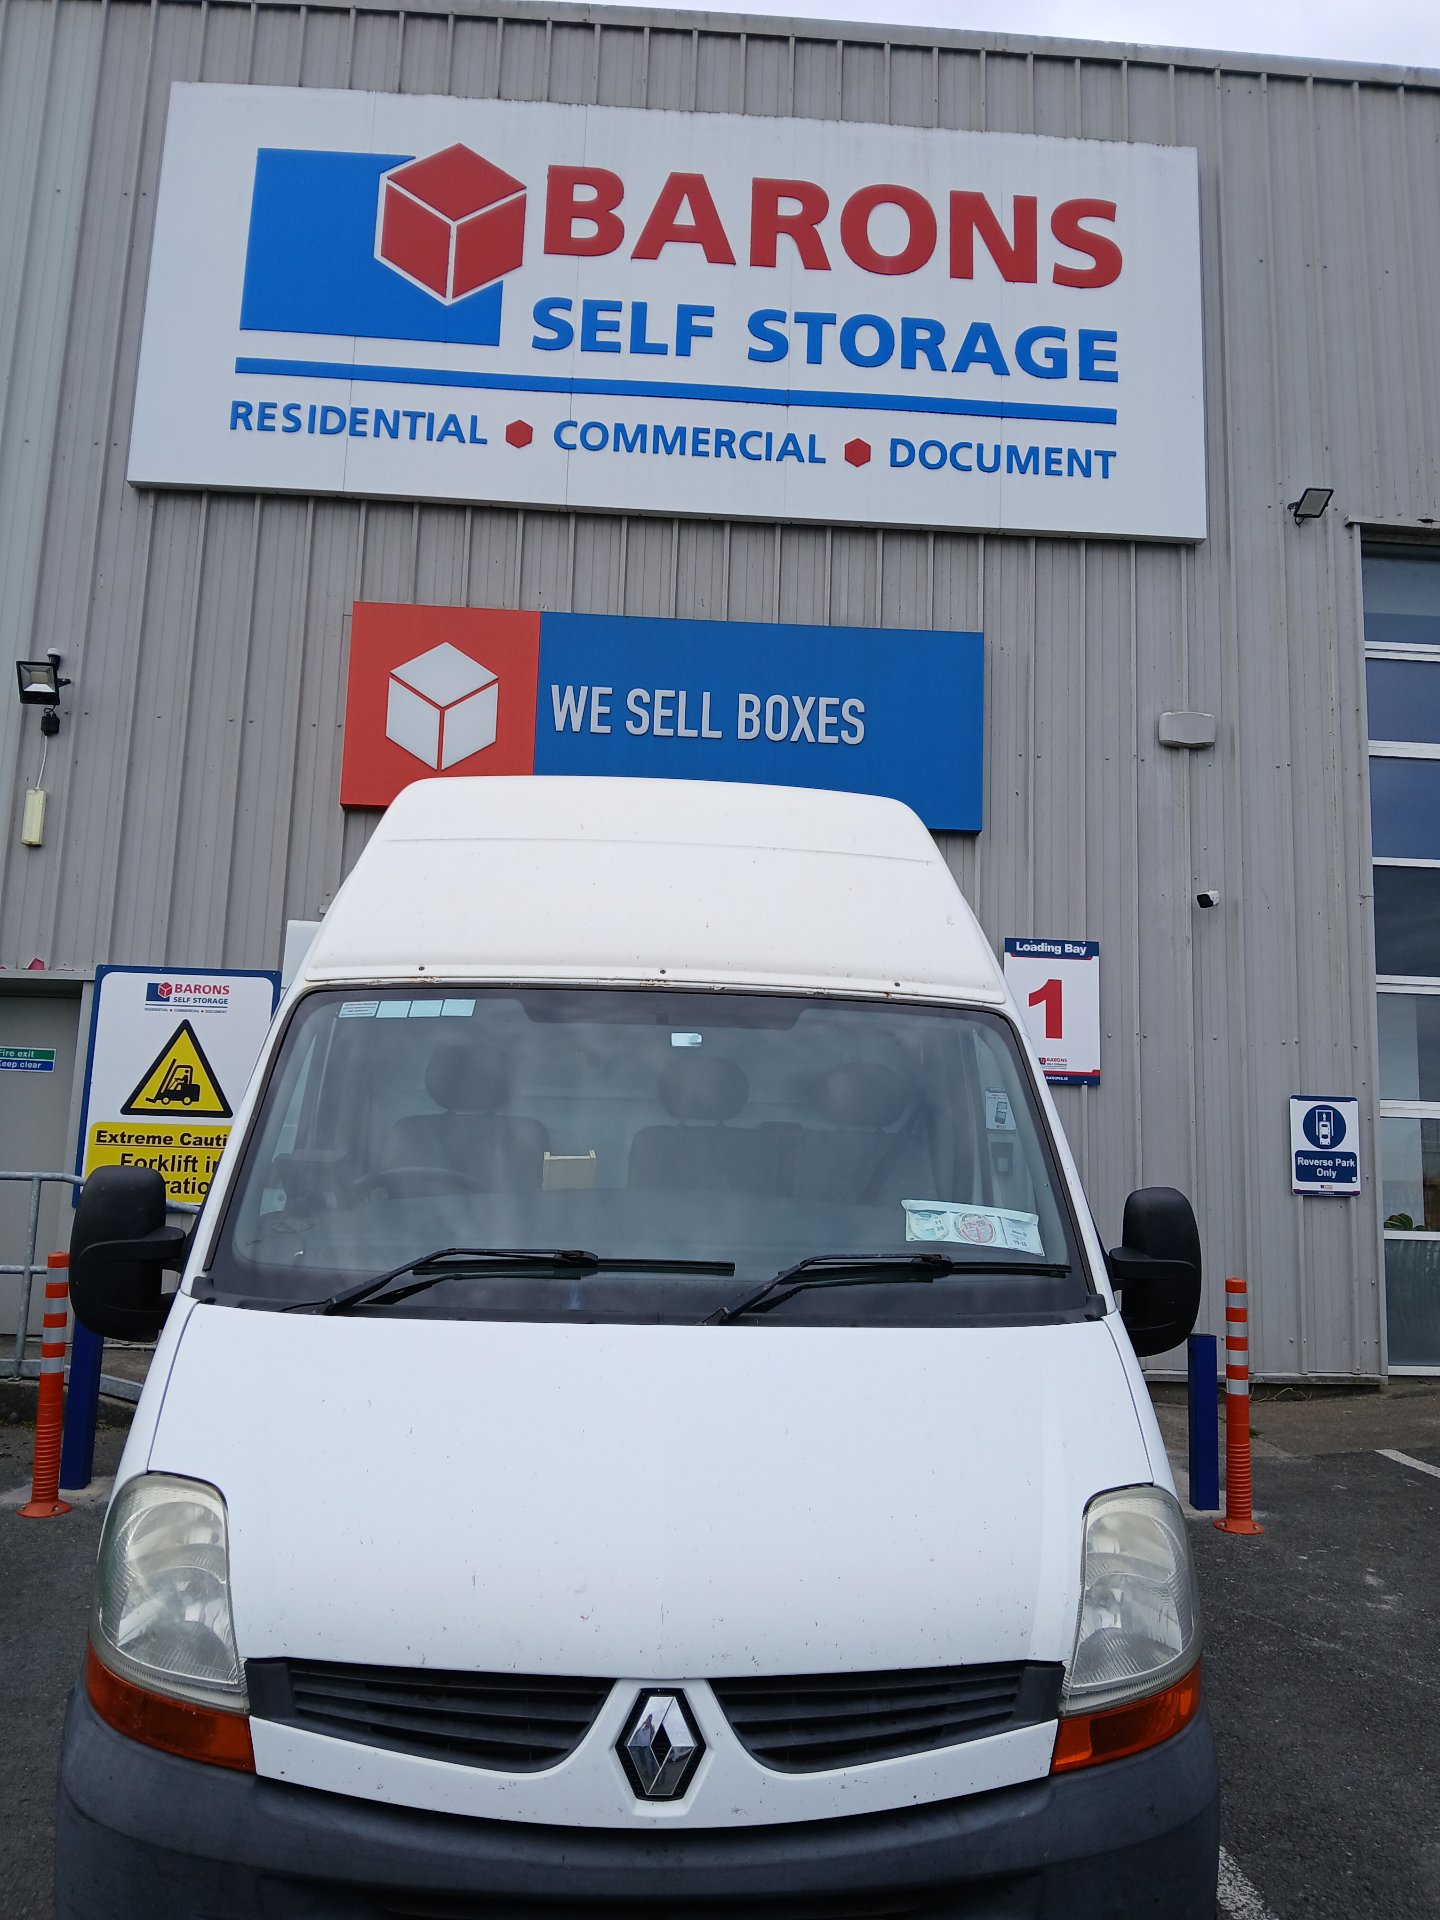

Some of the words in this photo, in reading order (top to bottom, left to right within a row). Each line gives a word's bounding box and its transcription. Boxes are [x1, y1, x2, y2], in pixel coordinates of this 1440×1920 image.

[543, 164, 1123, 289] BARONS
[531, 296, 715, 357] SELF
[746, 308, 1120, 383] STORAGE
[229, 400, 489, 446] RESIDENTIAL
[553, 420, 827, 465] COMMERCIAL
[888, 437, 1118, 480] DOCUMENT
[551, 683, 613, 735] WE
[625, 687, 723, 740] SELL
[737, 693, 867, 746] BOXES
[1015, 941, 1062, 955] Loading
[1064, 943, 1088, 956] Bay
[174, 983, 230, 995] BARONS
[193, 997, 229, 1005] STORAGE
[1028, 978, 1063, 1040] 1
[17, 1050, 35, 1058] exit
[0, 1060, 18, 1069] eep
[20, 1061, 42, 1069] clear
[95, 1129, 174, 1145] Extreme
[179, 1132, 228, 1147] Cauti
[120, 1152, 199, 1173] Forklift
[1297, 1156, 1334, 1167] Reverse
[1335, 1158, 1356, 1167] Park
[1316, 1168, 1338, 1179] Only
[164, 1176, 210, 1195] ratio
